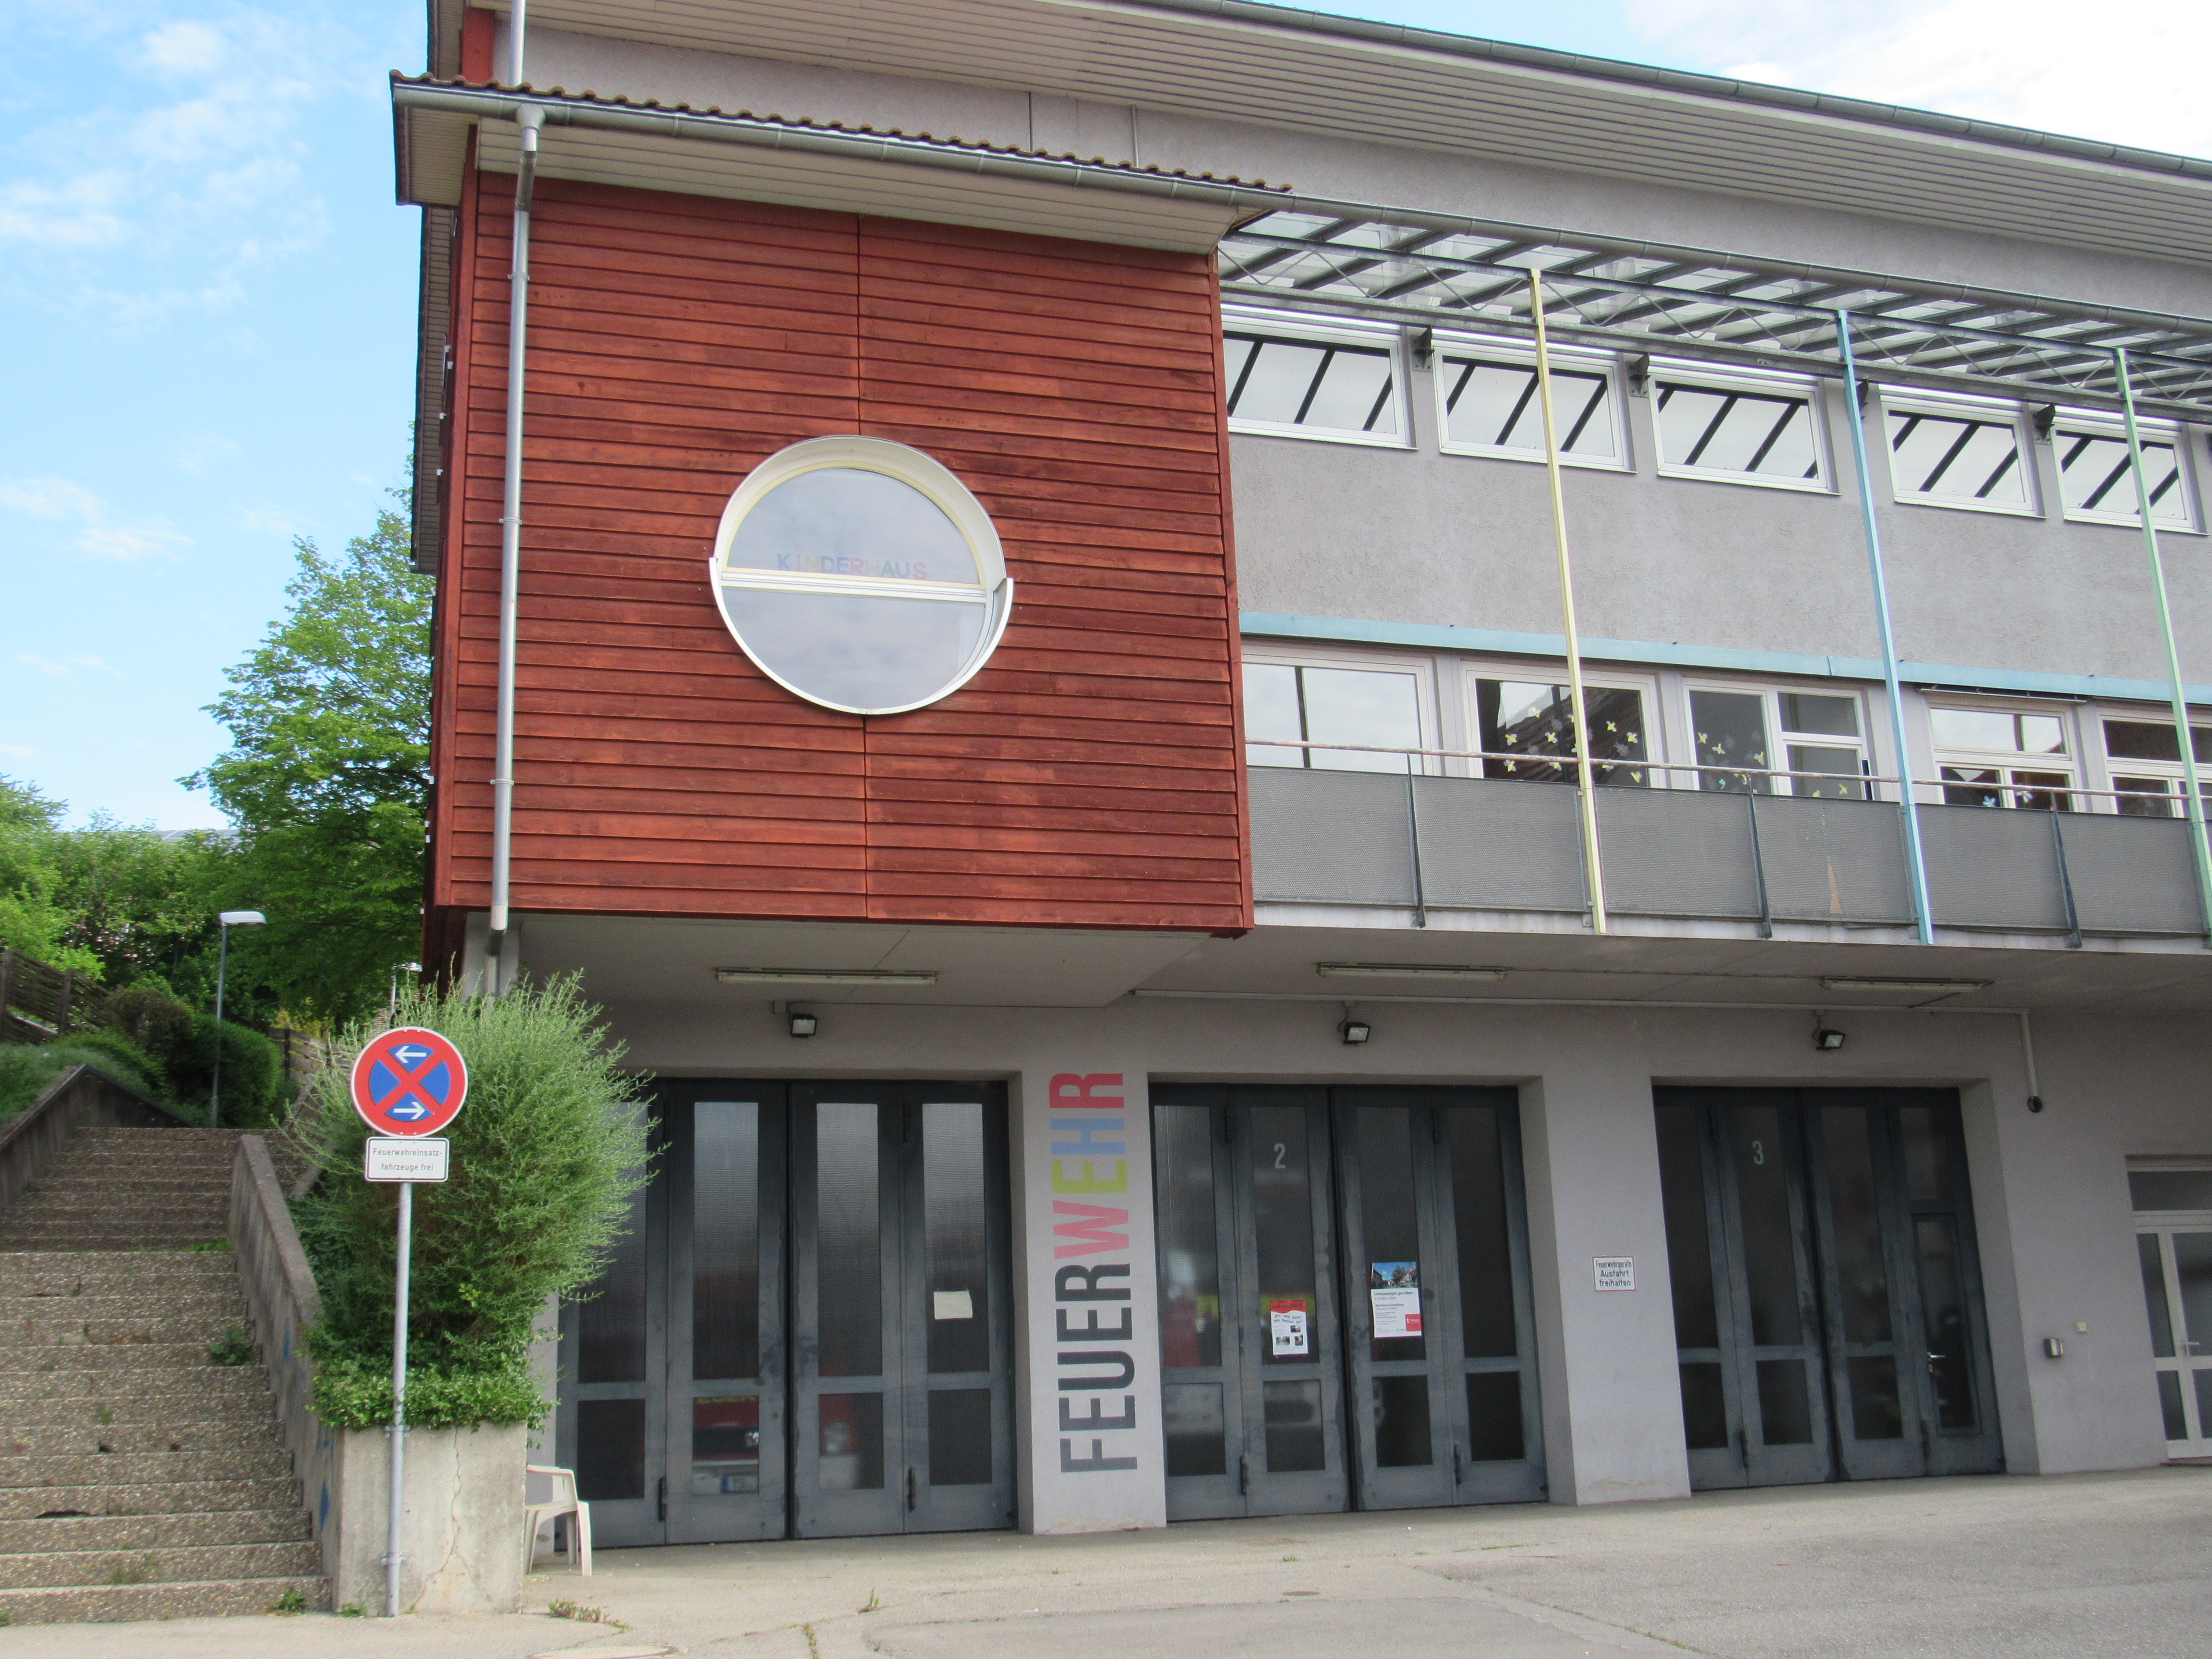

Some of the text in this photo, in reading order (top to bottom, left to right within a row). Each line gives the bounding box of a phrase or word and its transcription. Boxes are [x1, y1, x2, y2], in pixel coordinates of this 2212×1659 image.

[778, 553, 927, 580] KINDERHAUS
[373, 1148, 442, 1156] Feuerwehreinsatz-
[1274, 1142, 1286, 1169] 2
[1752, 1141, 1764, 1165] 3
[381, 1163, 419, 1172] fahrzeuge
[1048, 1072, 1138, 1473] FEUERWEHR
[1600, 1269, 1629, 1277] Ausfahrt
